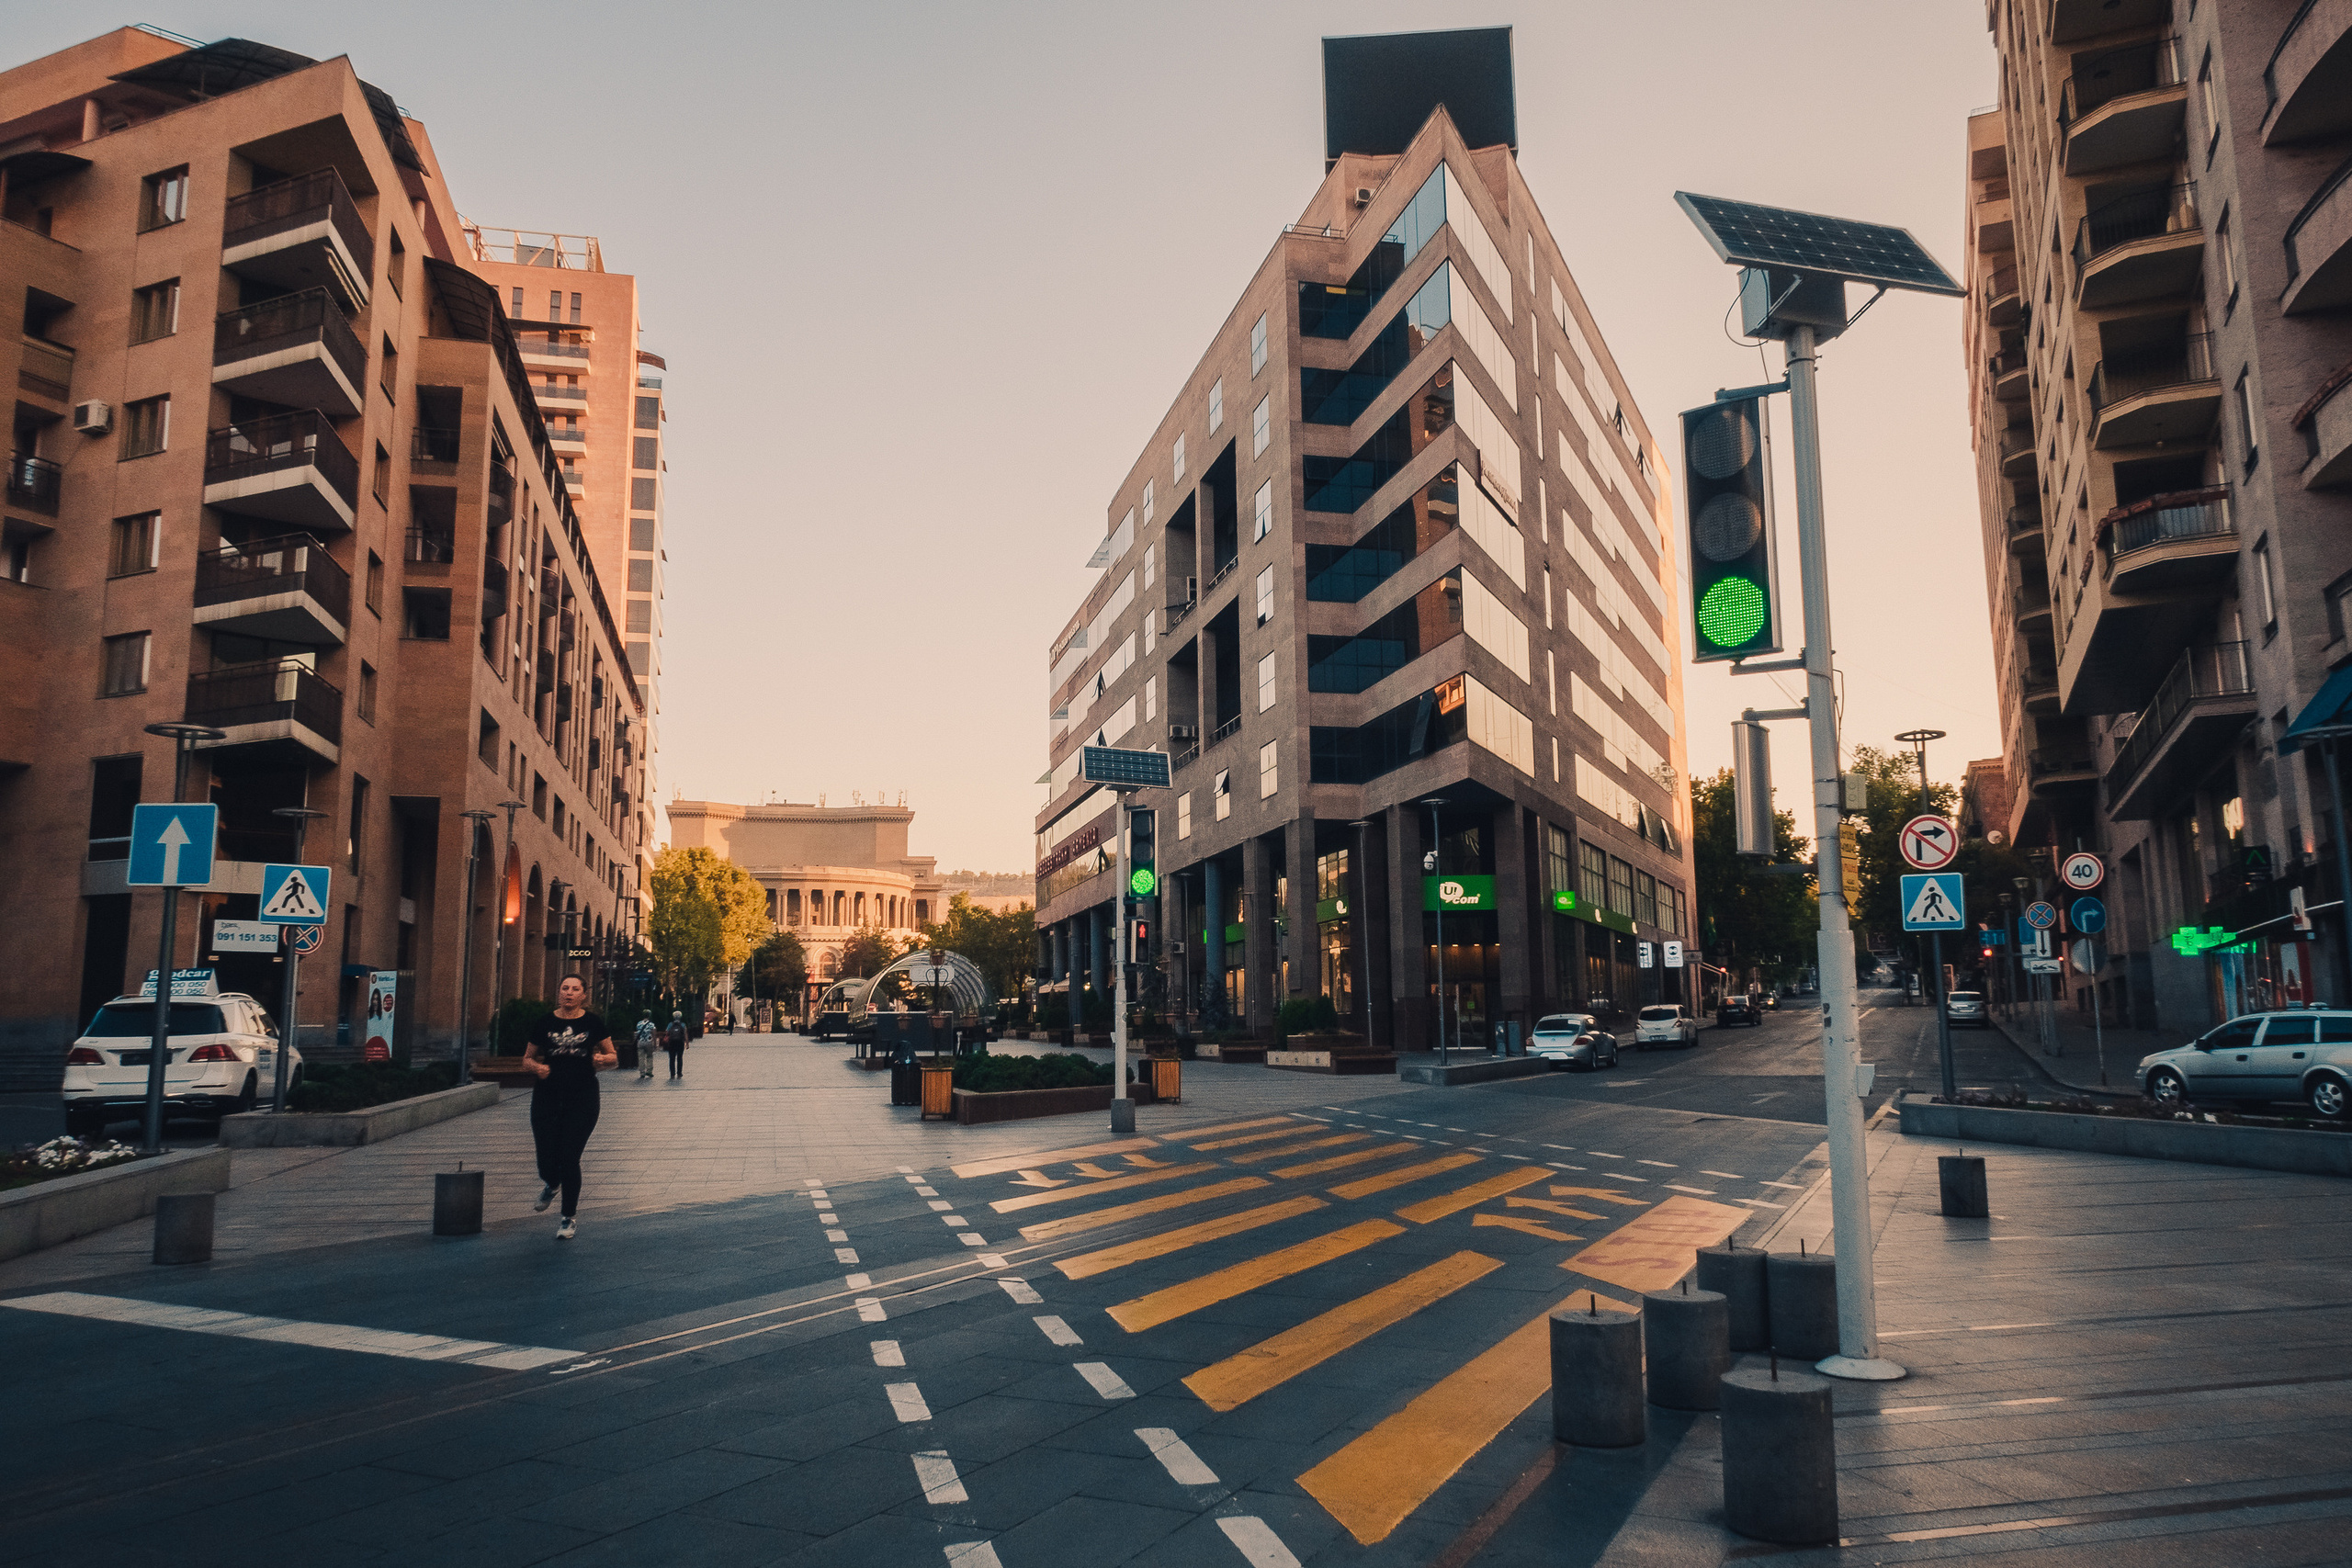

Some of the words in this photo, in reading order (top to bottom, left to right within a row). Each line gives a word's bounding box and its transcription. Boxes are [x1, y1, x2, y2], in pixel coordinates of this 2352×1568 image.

[2072, 864, 2092, 878] 40
[217, 932, 235, 941] 091
[239, 933, 255, 942] 151
[259, 934, 277, 942] 353
